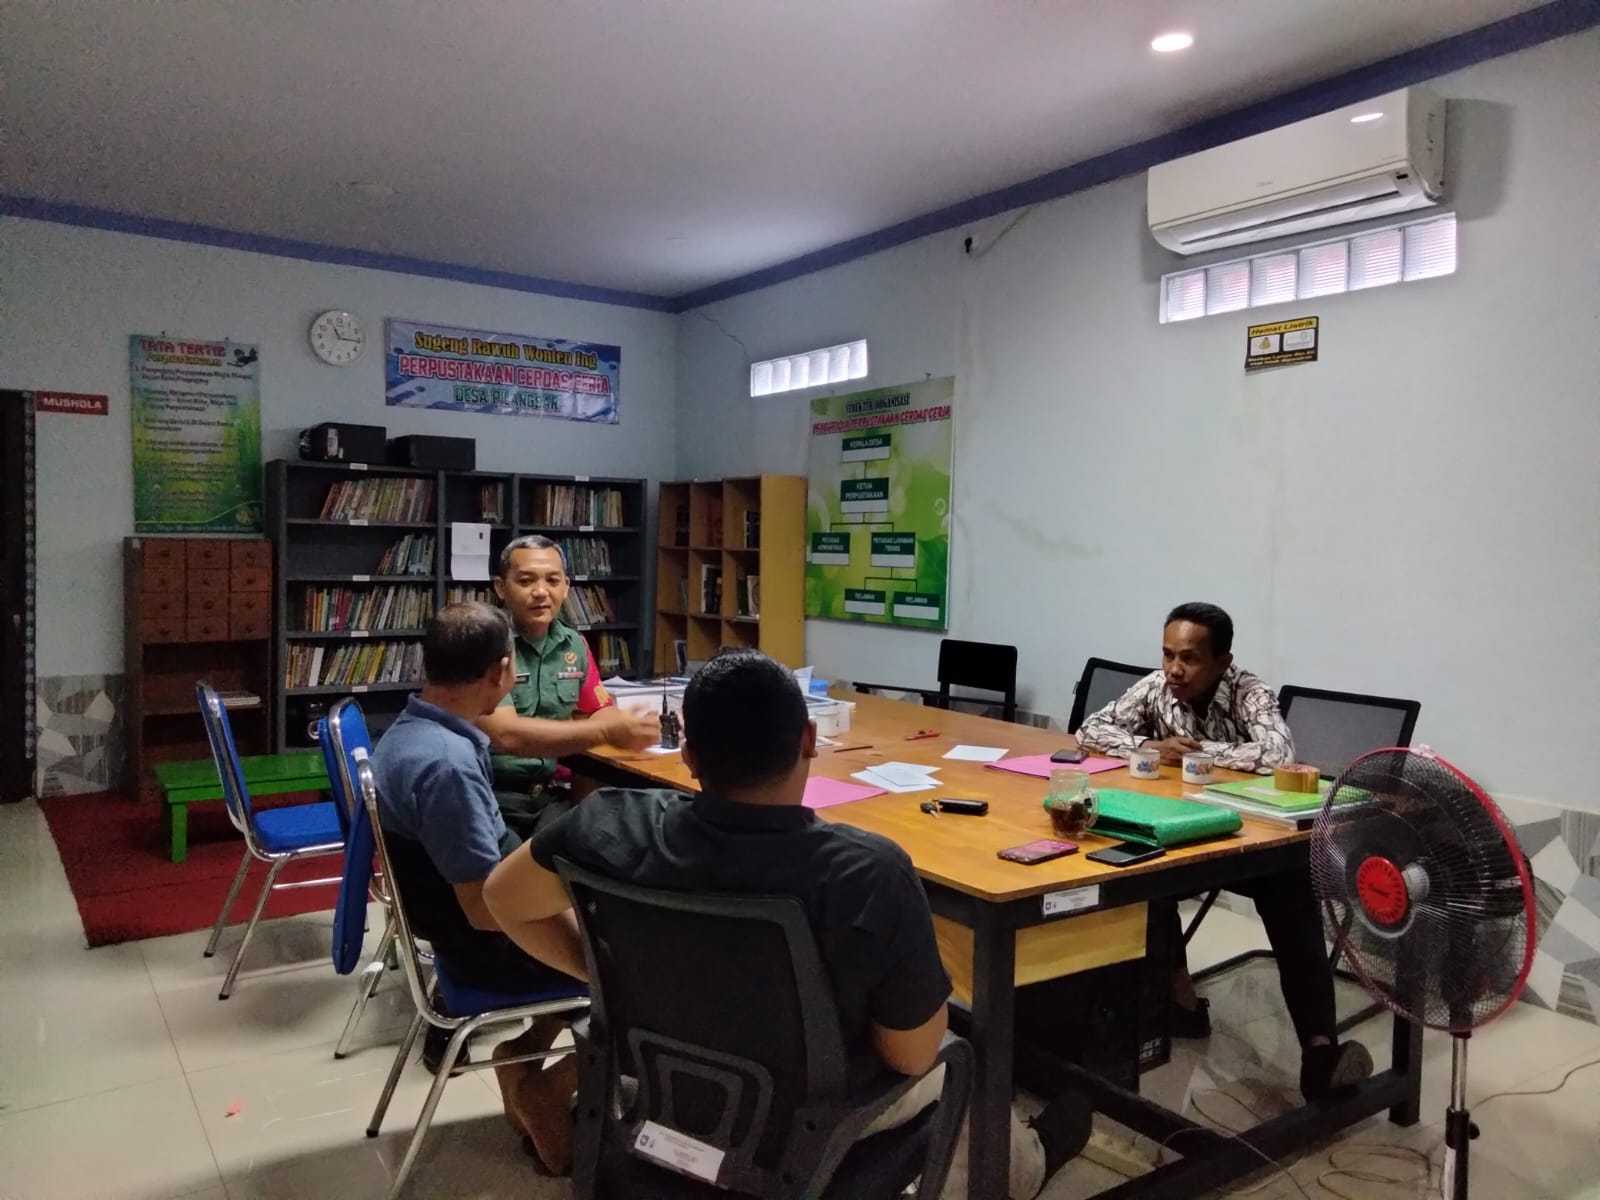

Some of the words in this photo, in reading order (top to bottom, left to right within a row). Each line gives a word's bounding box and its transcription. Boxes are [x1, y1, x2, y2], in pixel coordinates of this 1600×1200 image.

[1250, 326, 1282, 336] Hemat
[1284, 320, 1314, 330] Listrik
[141, 339, 175, 354] TATA
[414, 331, 469, 356] Sugeng
[471, 338, 520, 360] Rawuh
[574, 350, 598, 371] Ing
[399, 354, 514, 386] PERPUSTAKAAN
[516, 366, 571, 391] CERDAS
[43, 397, 103, 409] MUSHOLA
[454, 384, 488, 404] DESA
